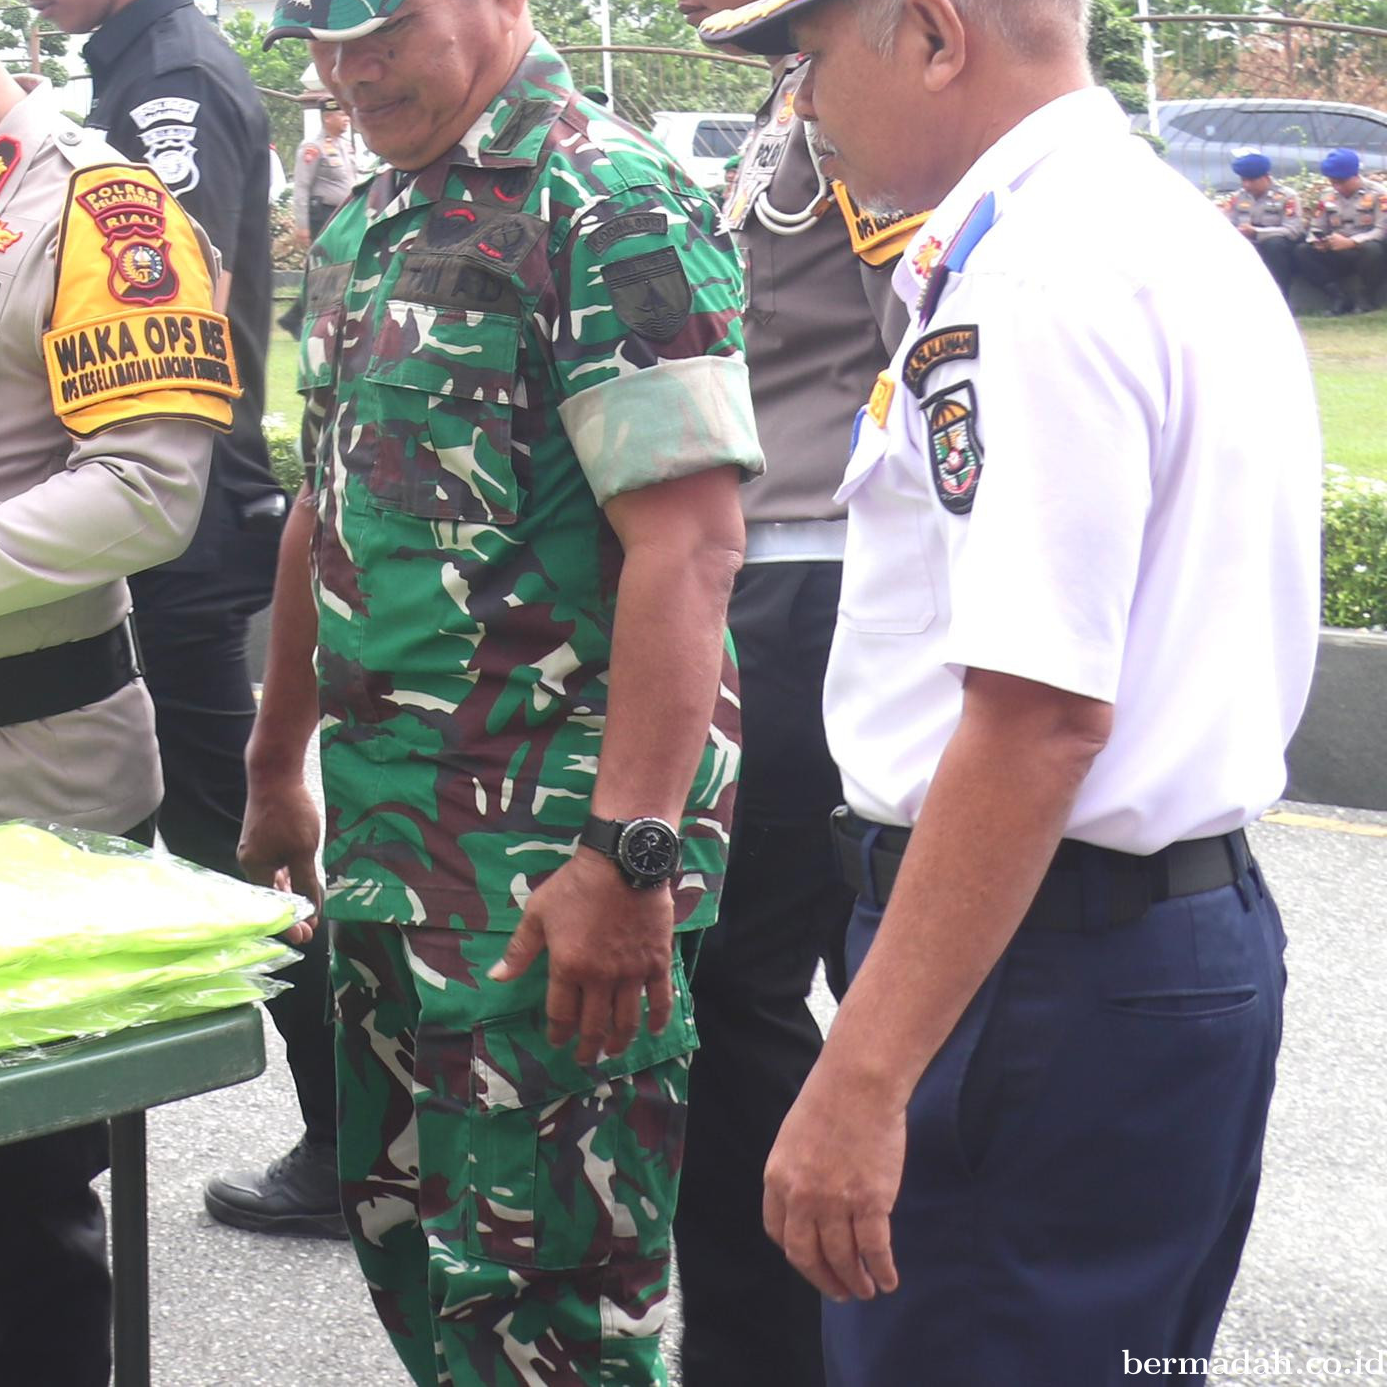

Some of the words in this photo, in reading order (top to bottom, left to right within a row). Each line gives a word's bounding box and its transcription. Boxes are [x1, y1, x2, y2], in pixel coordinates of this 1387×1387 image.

[84, 183, 158, 206] POLRES
[93, 194, 158, 211] PELALAWAN
[105, 214, 158, 229] RIAU
[53, 320, 139, 377] WAKA
[143, 315, 197, 355] OPS
[61, 376, 80, 404] OPS
[79, 357, 153, 397] KESELAMATAN
